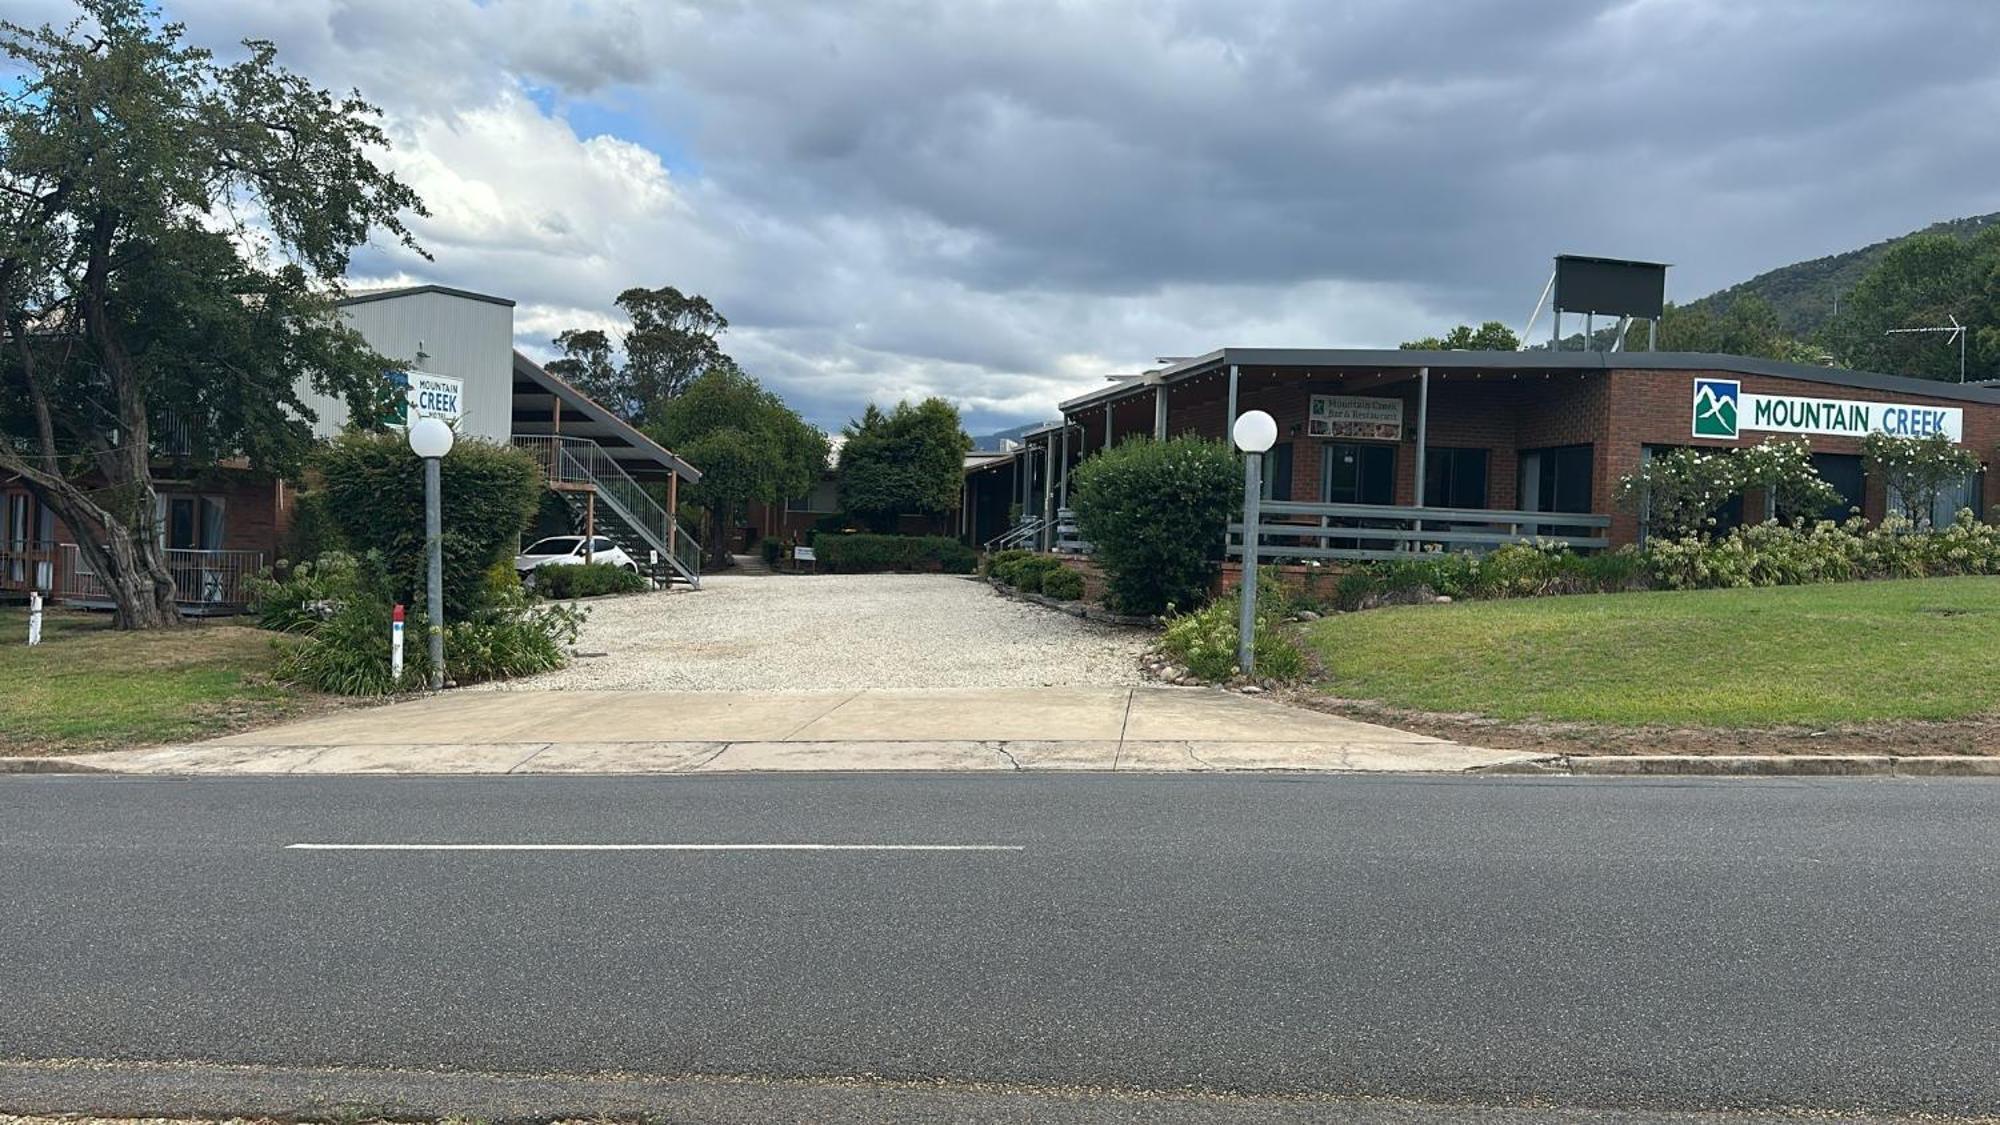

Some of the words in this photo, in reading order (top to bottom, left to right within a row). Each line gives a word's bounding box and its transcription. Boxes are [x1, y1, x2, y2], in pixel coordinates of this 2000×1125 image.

[419, 380, 458, 394] MOUNTAIN
[420, 391, 457, 413] CREEK
[1328, 399, 1371, 409] Mountain
[1755, 399, 1869, 432] MOUNTAIN
[1883, 408, 1947, 436] CREEK
